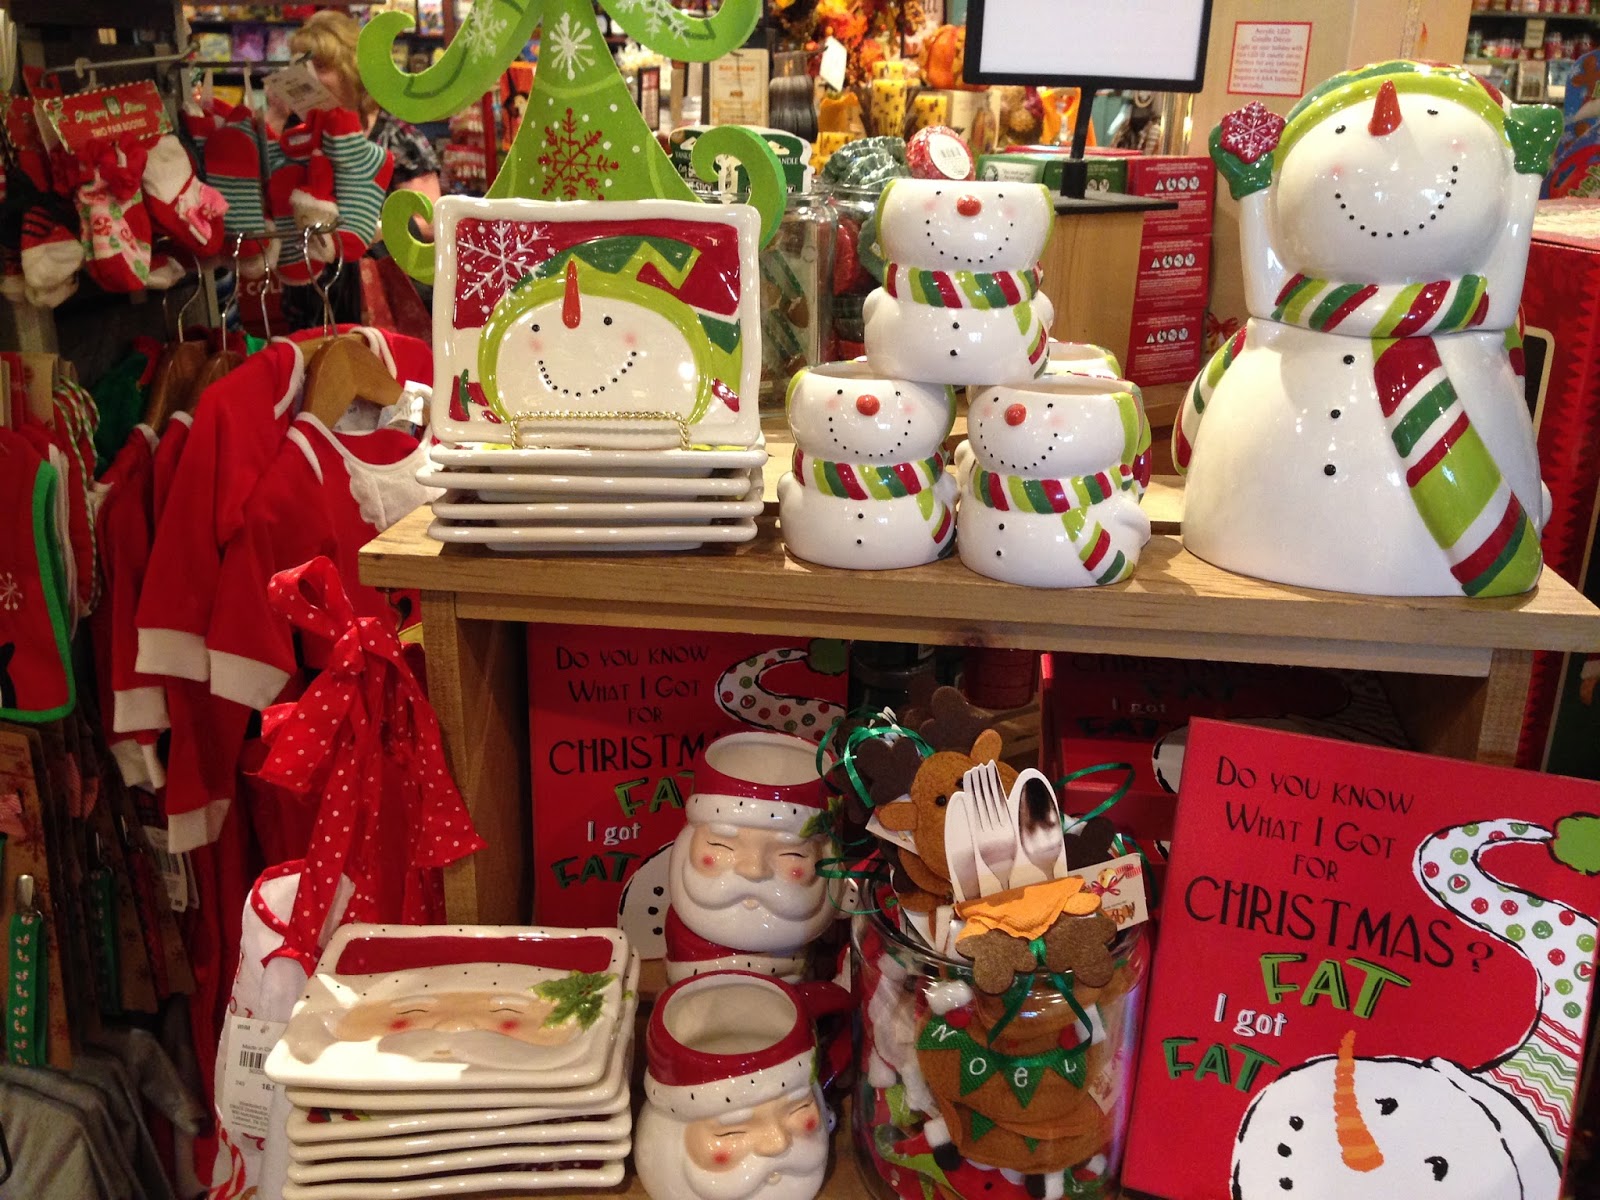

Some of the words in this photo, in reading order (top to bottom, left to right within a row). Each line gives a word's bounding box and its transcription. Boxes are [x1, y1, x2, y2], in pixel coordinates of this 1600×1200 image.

[648, 645, 710, 665] KNOW
[640, 675, 646, 699] I
[628, 706, 663, 725] FOR
[1271, 772, 1321, 800] YOU
[1332, 782, 1415, 815] KNOW
[587, 820, 596, 842] I
[603, 822, 641, 846] got
[1314, 816, 1324, 847] I
[551, 851, 641, 890] FAT
[1293, 853, 1339, 882] FOR
[1259, 952, 1412, 1019] FAT
[1214, 992, 1227, 1023] I
[1233, 1008, 1288, 1037] got
[1161, 1035, 1281, 1094] FAT
